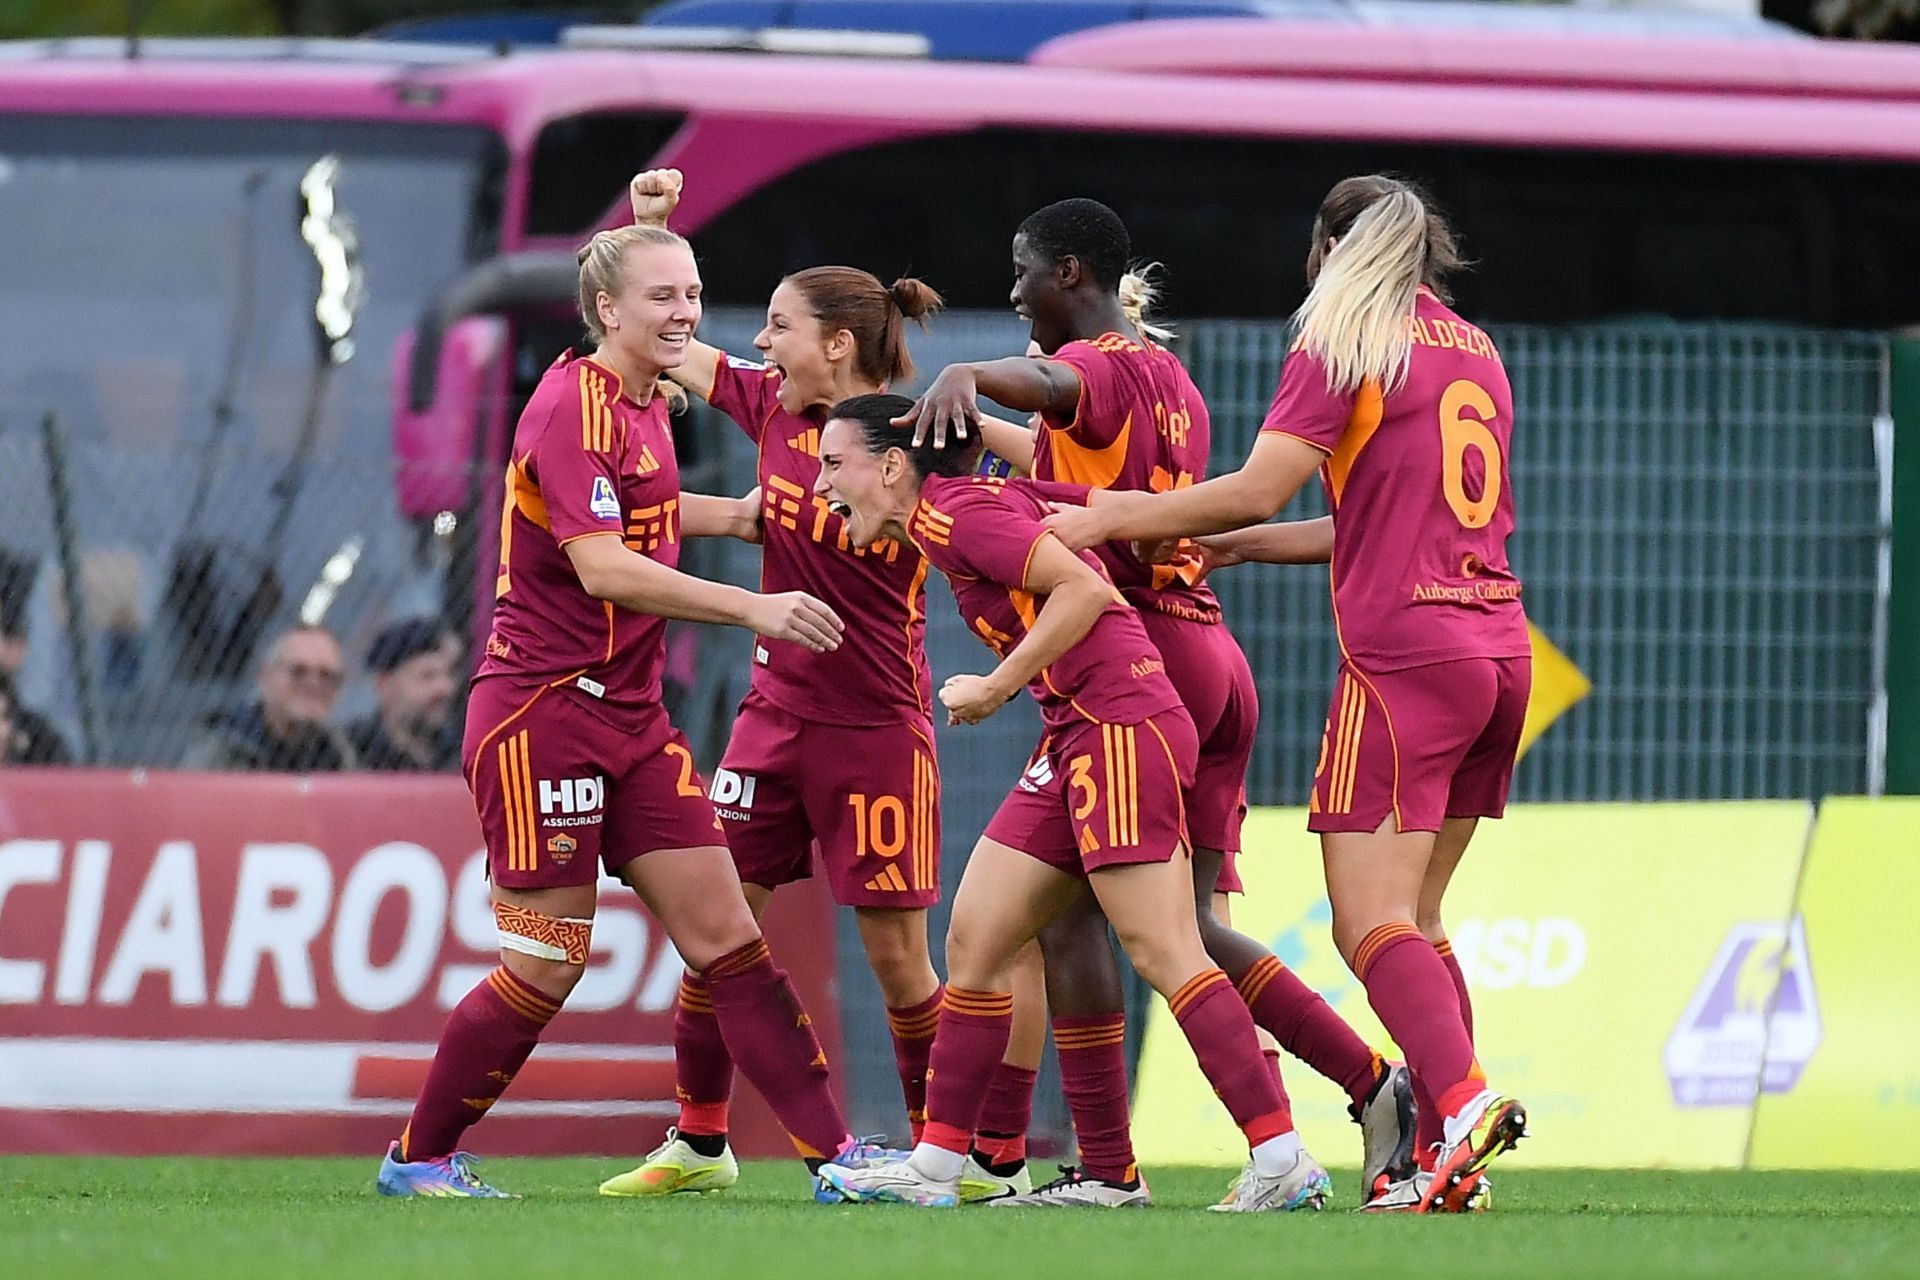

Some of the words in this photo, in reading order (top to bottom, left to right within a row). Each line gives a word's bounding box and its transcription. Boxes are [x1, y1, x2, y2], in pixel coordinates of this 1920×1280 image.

[1439, 379, 1501, 529] 6
[1070, 754, 1098, 820] 3
[848, 794, 906, 858] 10
